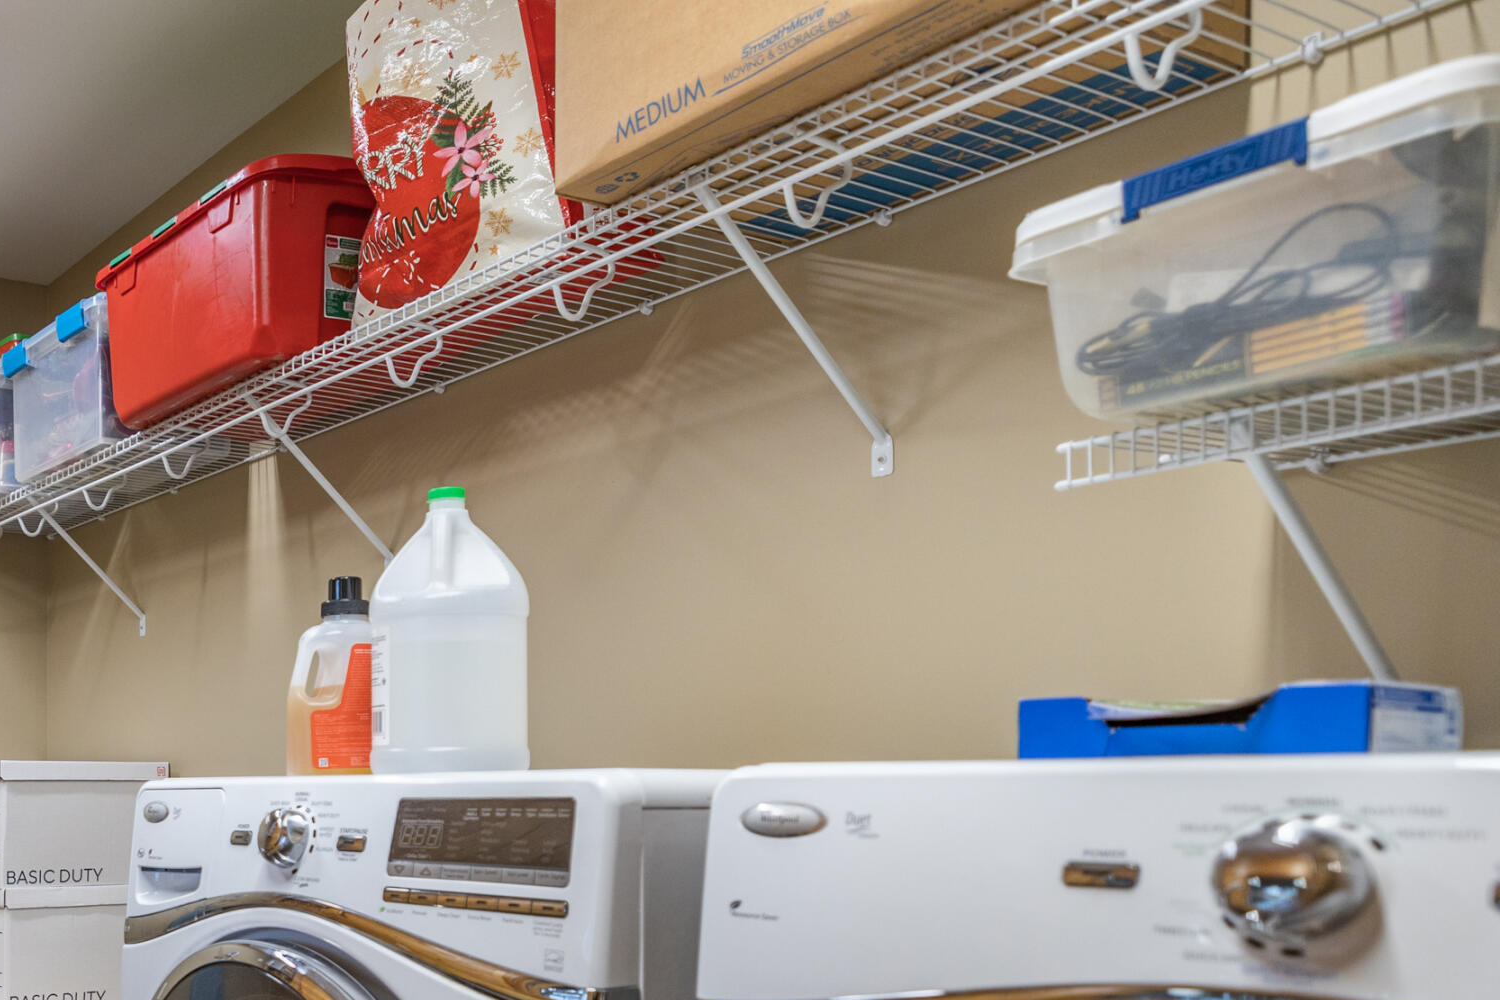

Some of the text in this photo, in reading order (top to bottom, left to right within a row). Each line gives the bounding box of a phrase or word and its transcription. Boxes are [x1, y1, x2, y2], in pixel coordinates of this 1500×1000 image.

[723, 54, 765, 83] MOVING
[777, 23, 825, 55] STORAGE
[827, 9, 851, 27] BOX
[615, 75, 706, 143] MEDIUM
[356, 122, 429, 190] RRY
[1168, 151, 1251, 191] Hefty
[6, 867, 103, 885] BASIC DUTY
